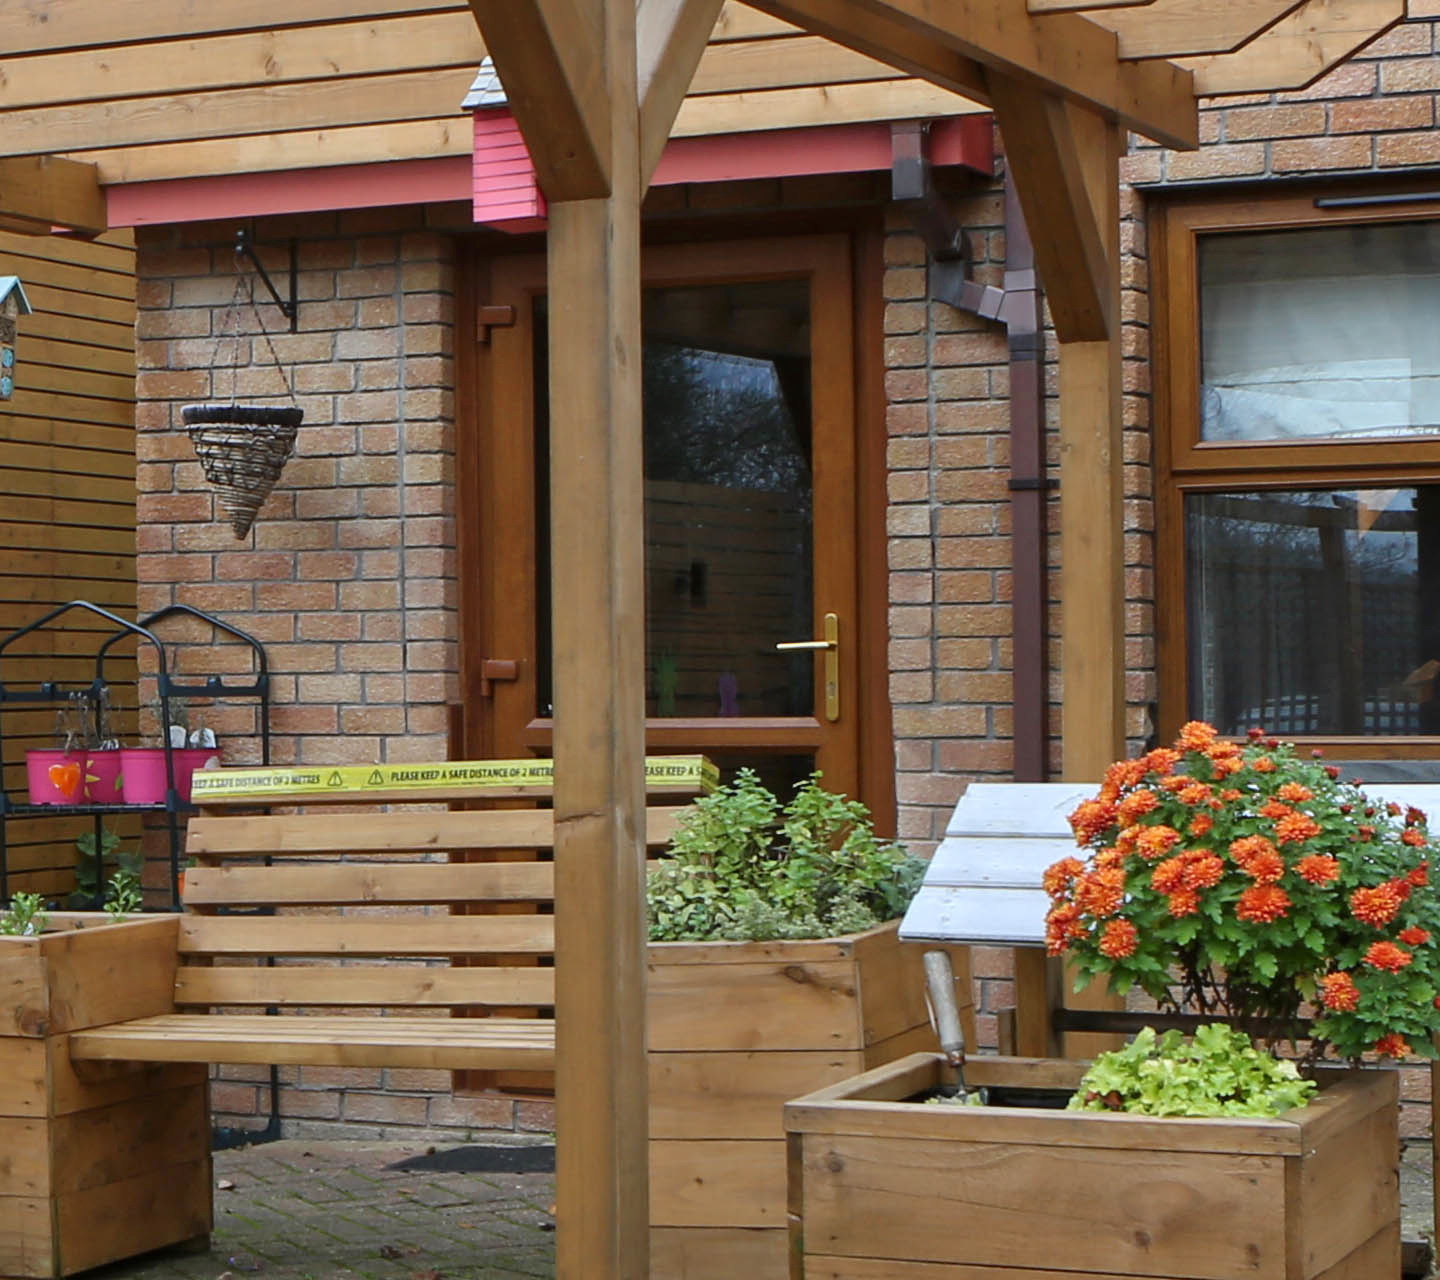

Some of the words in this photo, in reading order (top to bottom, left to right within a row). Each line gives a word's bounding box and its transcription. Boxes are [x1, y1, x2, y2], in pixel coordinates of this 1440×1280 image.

[391, 771, 419, 782] PLEASE
[421, 770, 440, 781] KEEP
[441, 770, 448, 780] A
[449, 769, 468, 780] SAFE
[470, 767, 508, 779] DISTANCE
[509, 767, 520, 778] OF
[529, 766, 552, 777] METR
[645, 766, 664, 776] EASE
[235, 776, 272, 787] DISTANCE
